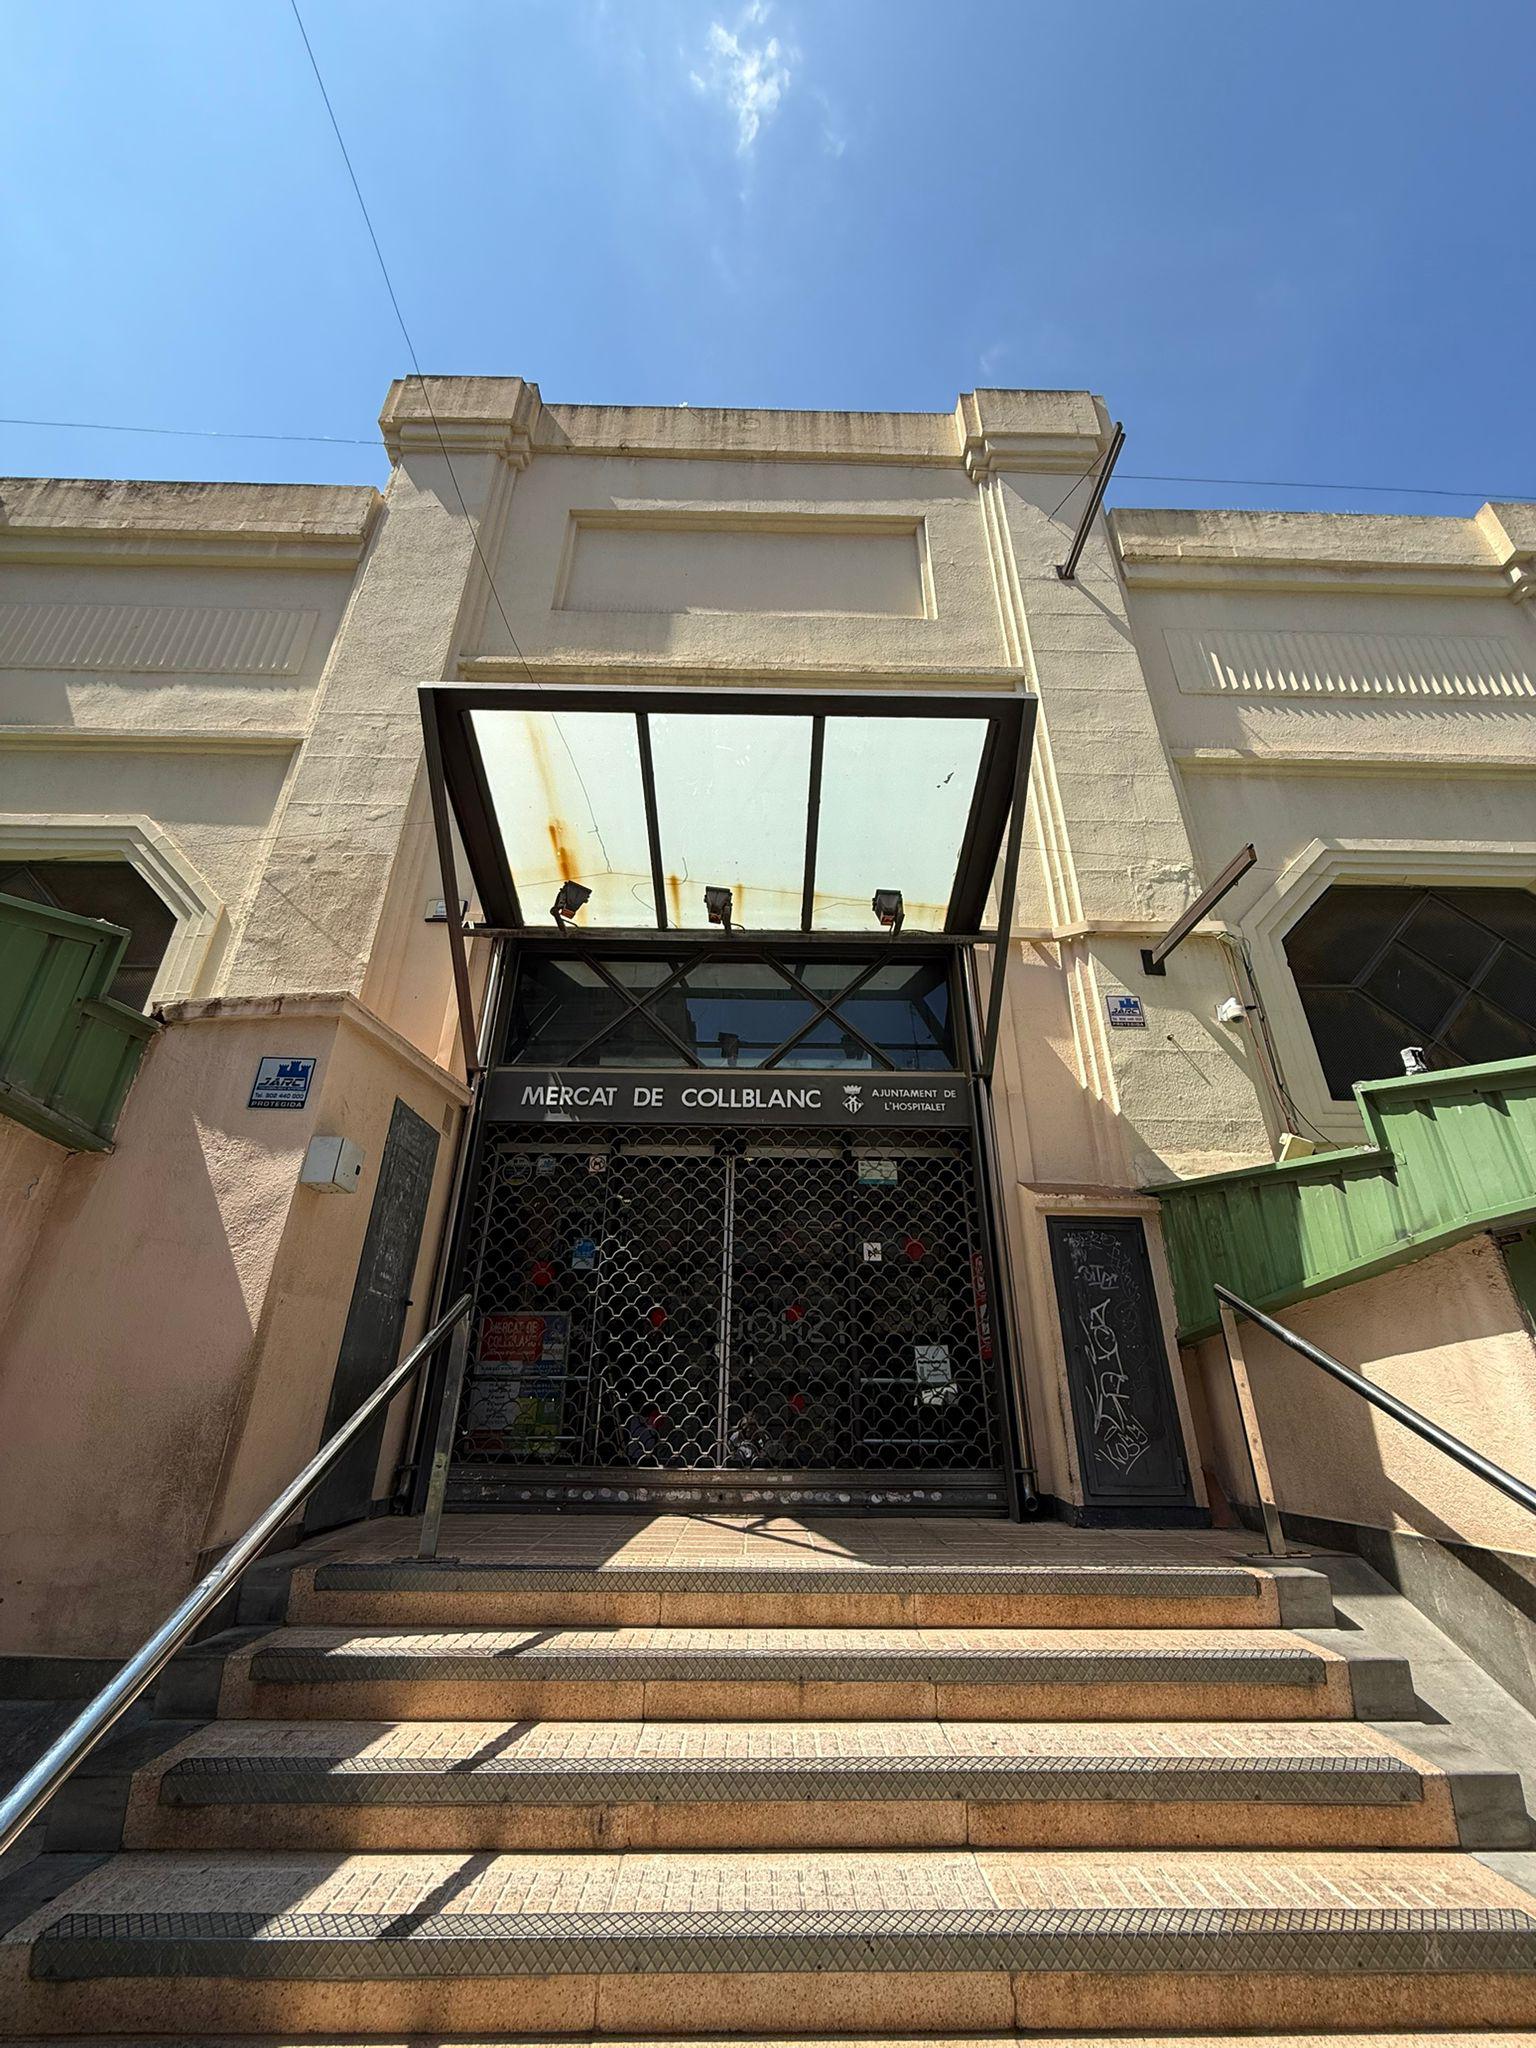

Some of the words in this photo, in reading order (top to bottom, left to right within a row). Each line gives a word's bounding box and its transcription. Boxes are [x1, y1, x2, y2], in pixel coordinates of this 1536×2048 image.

[258, 1077, 305, 1086] JARC
[521, 1086, 618, 1106] MERCAT
[633, 1087, 664, 1107] DE
[681, 1088, 822, 1108] COLLBLANC
[872, 1088, 937, 1098] AJUNTAMENT
[944, 1089, 957, 1098] DE
[884, 1102, 946, 1111] L'HOSPITALET
